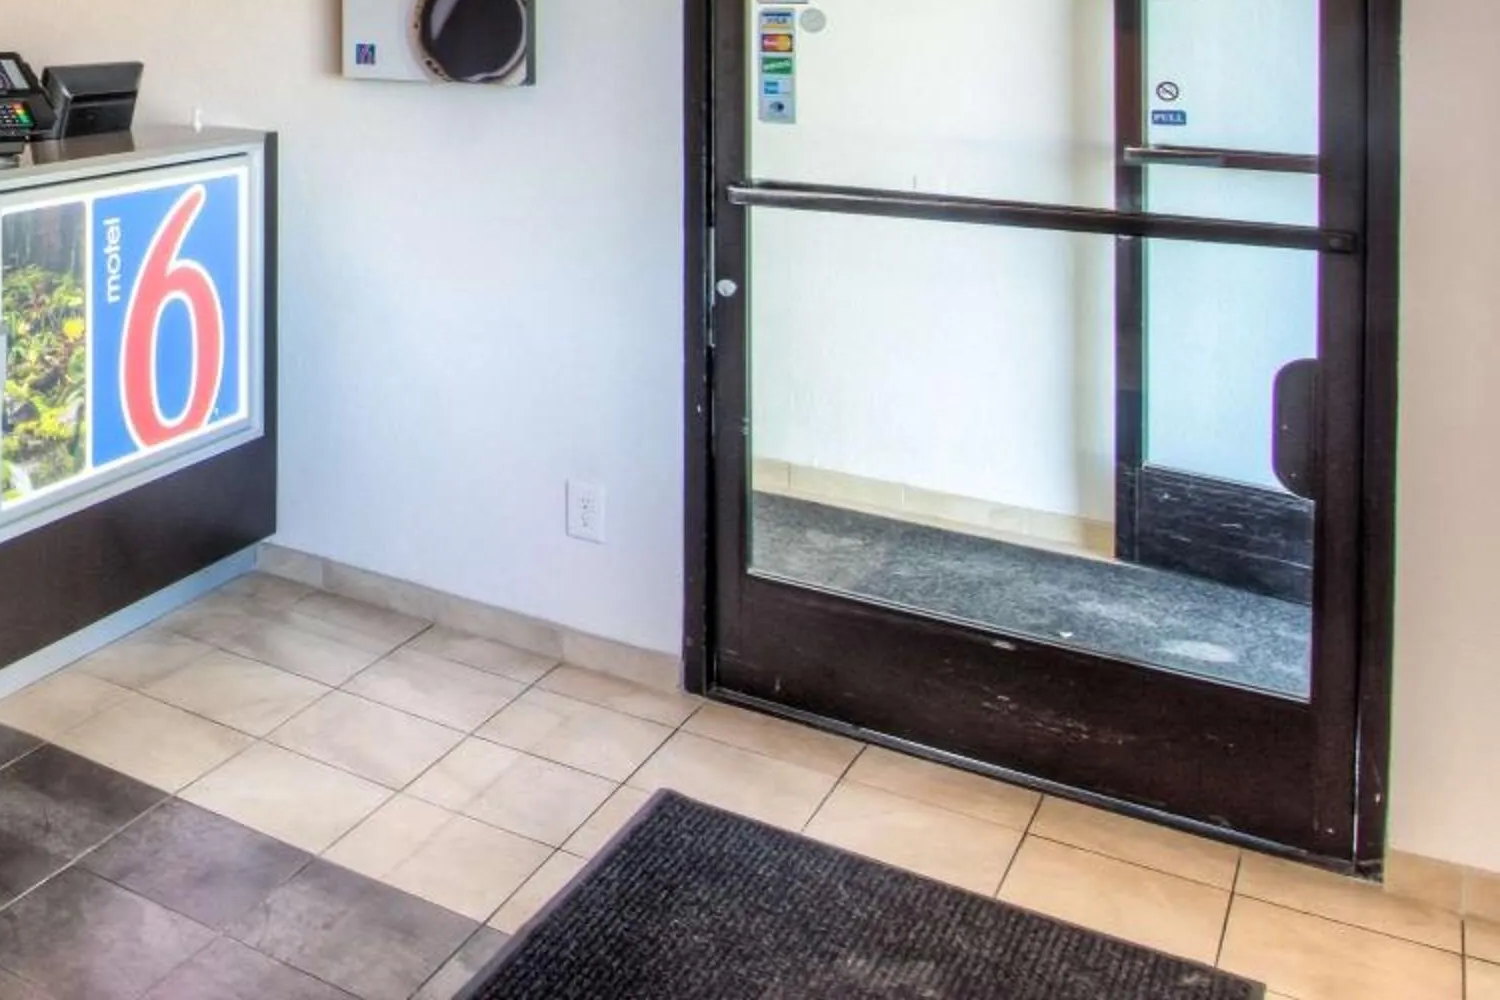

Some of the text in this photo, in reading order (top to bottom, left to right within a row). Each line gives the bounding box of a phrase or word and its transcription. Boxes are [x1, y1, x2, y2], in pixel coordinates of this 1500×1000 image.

[1153, 113, 1183, 122] PULL
[102, 183, 225, 451] motel 6
